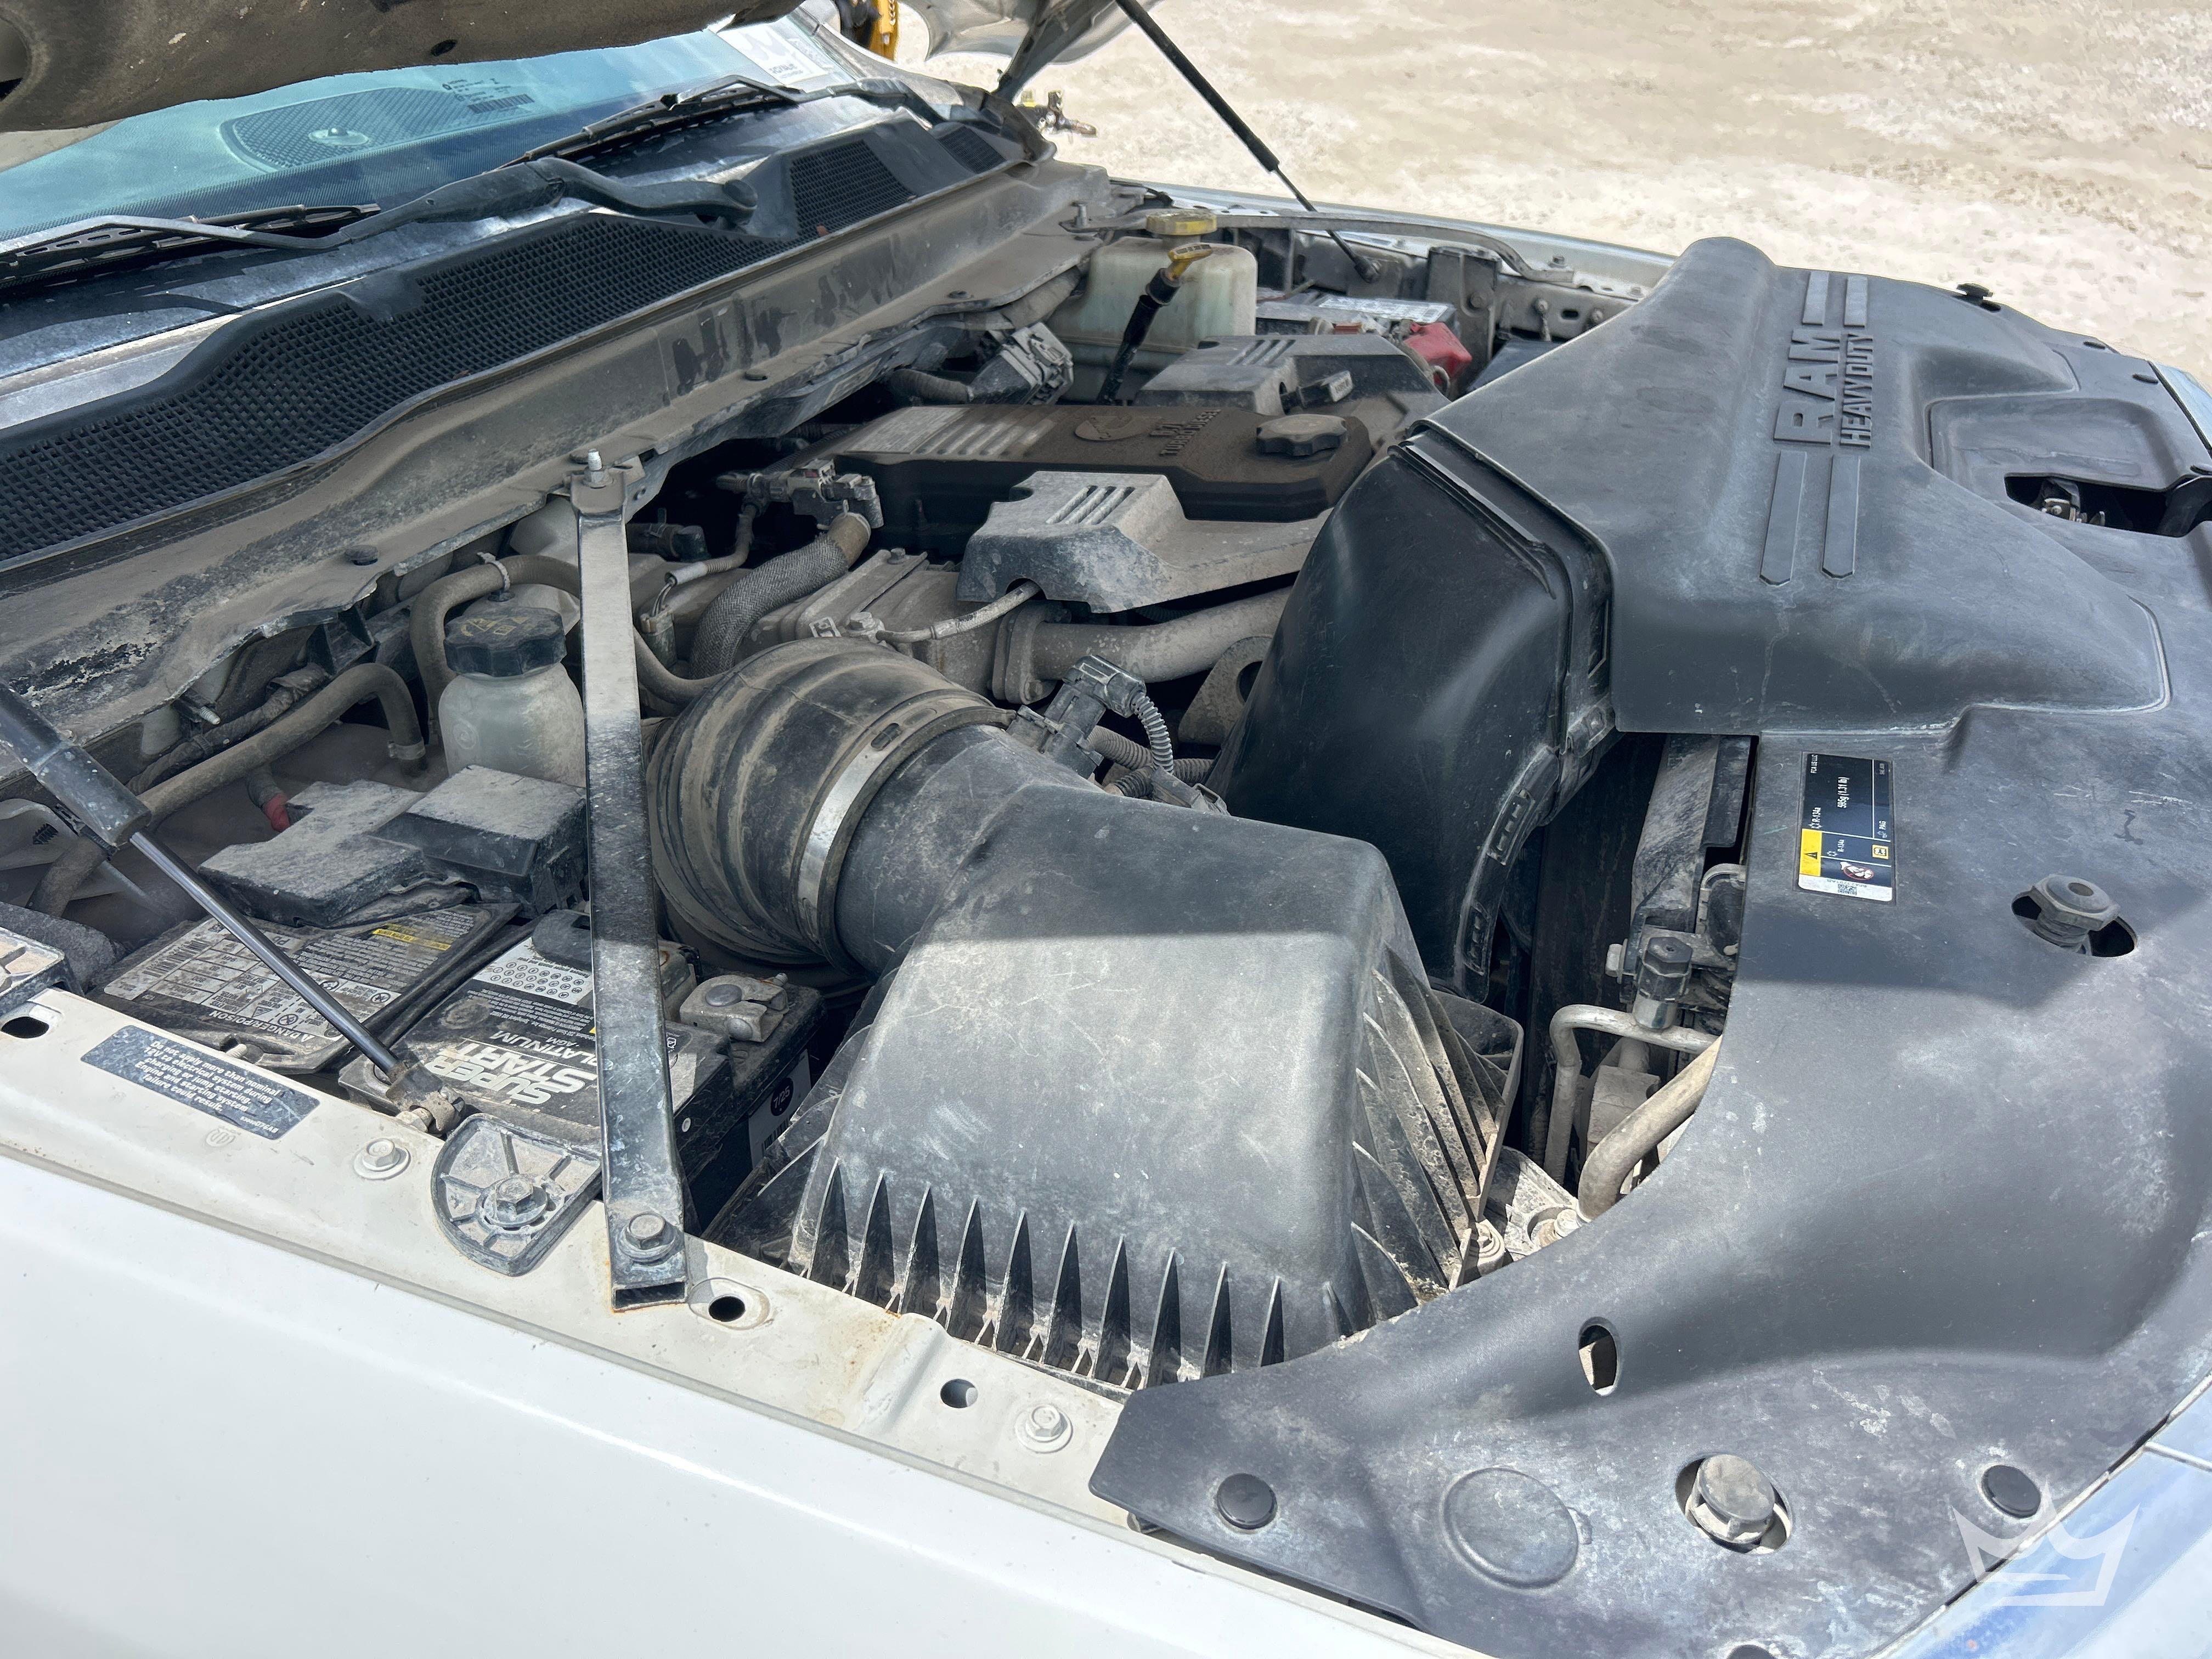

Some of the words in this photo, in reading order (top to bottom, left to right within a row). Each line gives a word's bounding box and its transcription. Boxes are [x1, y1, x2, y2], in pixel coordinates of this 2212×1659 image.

[1845, 332, 1874, 379] DUTY
[1773, 329, 1841, 445] RAM
[1159, 430, 1197, 456] TURBO
[1183, 409, 1222, 430] DIESEL
[1840, 380, 1872, 448] HEAVY
[1837, 795, 1849, 808] 595g
[1838, 785, 1849, 795] (1.31
[1812, 807, 1821, 823] R-134a
[208, 1010, 303, 1039] DANGER/POISON
[489, 1030, 598, 1066] PLATINUM
[545, 1036, 574, 1047] AGM
[134, 1060, 163, 1077] Engine
[162, 1073, 182, 1084] and
[179, 1080, 216, 1099] starting
[215, 1095, 249, 1113] system
[143, 1046, 164, 1058] 12V
[161, 1053, 173, 1062] to
[171, 1057, 214, 1079] electrical
[211, 1075, 245, 1092] system
[243, 1087, 273, 1104] during
[143, 1056, 181, 1076] charging
[181, 1071, 193, 1080] or
[191, 1075, 215, 1089] jump
[213, 1085, 253, 1104] starting.
[150, 1040, 164, 1049] Do
[163, 1046, 179, 1056] not
[178, 1051, 203, 1066] apply
[201, 1062, 224, 1074] more
[224, 1069, 246, 1082] than
[245, 1079, 280, 1096] nominal
[425, 1056, 551, 1104] SUPER
[437, 1043, 597, 1093] START
[141, 1073, 171, 1089] failure
[170, 1085, 195, 1099] could
[193, 1094, 224, 1111] result.
[774, 1086, 790, 1108] 7/25
